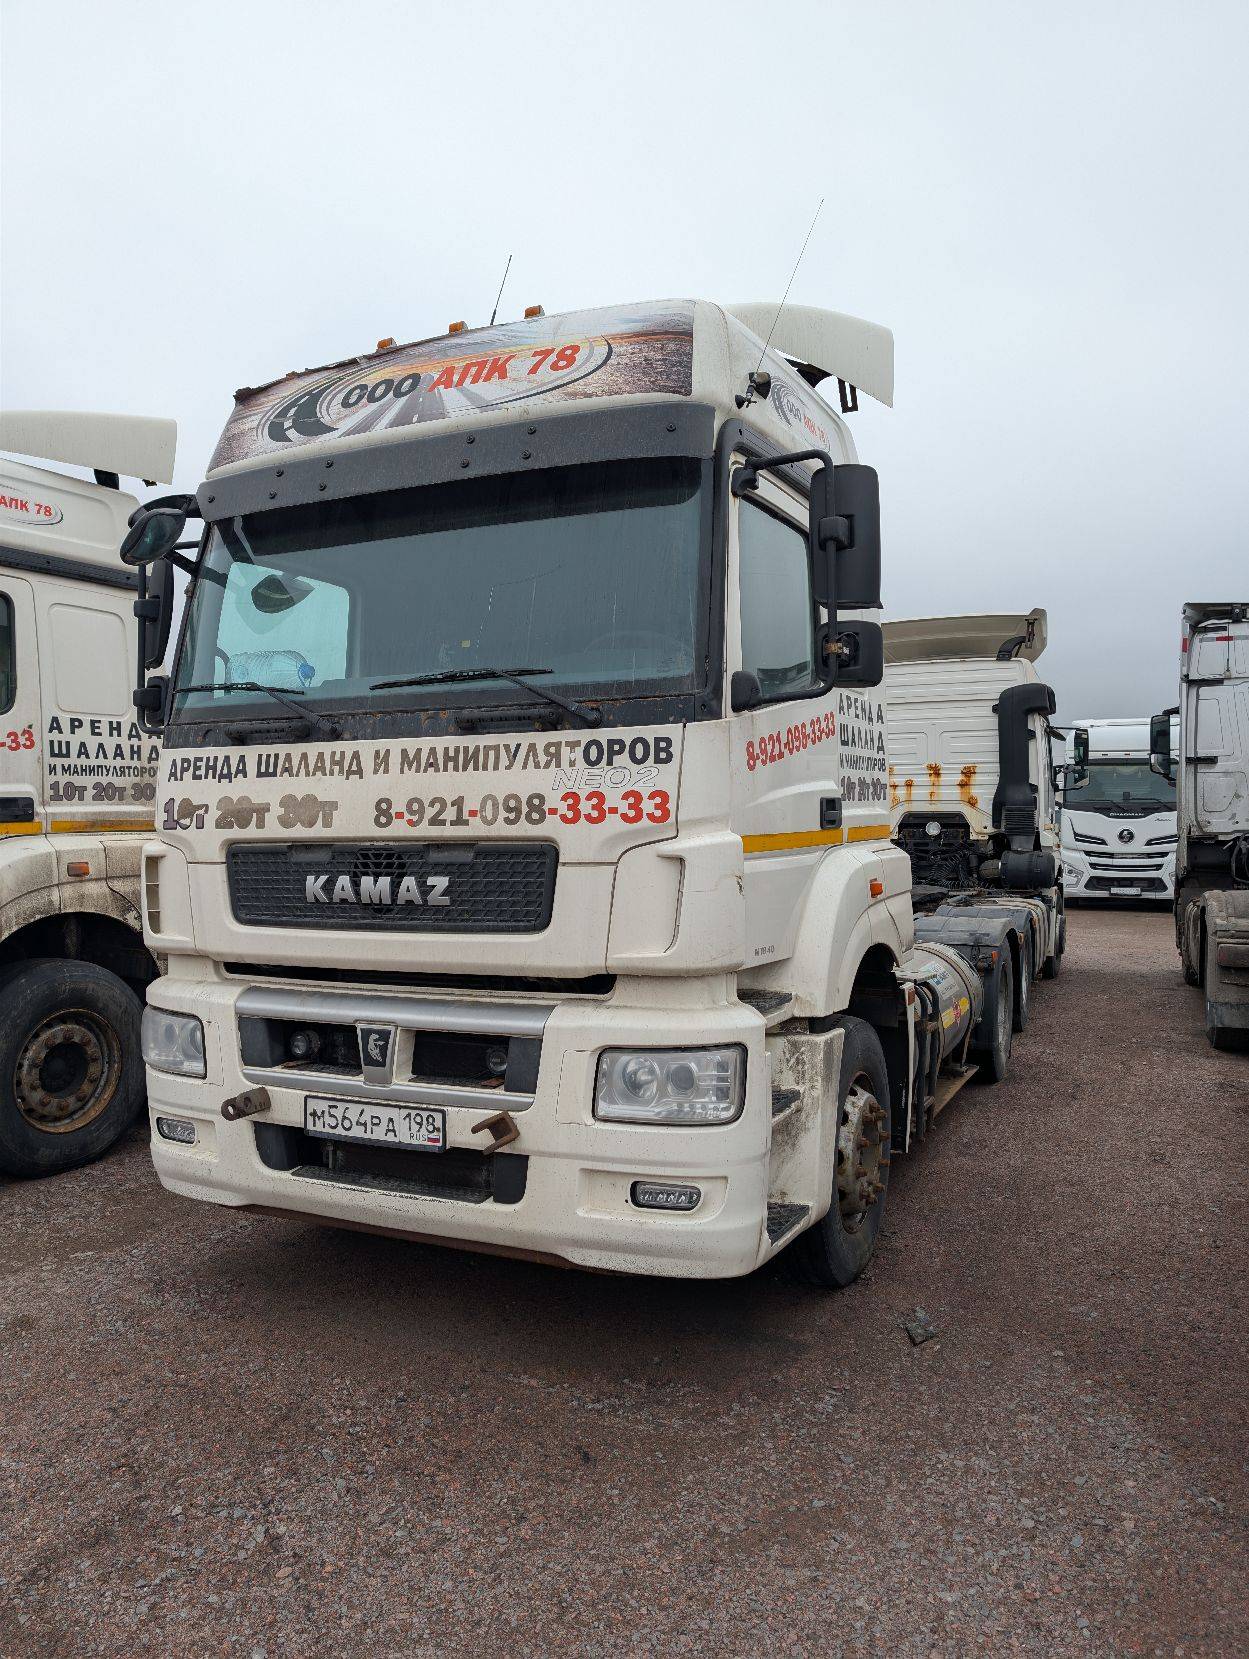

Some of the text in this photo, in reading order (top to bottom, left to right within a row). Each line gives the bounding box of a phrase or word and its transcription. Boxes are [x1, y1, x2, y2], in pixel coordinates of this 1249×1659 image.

[340, 343, 582, 408] ООО АПК 78
[0, 495, 52, 517] АПК 78
[838, 692, 885, 726] АРЕНДА
[746, 711, 836, 771] 8-921-098-33-33
[839, 723, 886, 755] ШАЛАНД
[48, 764, 158, 778] И МАНИПУЛЯТОРО
[168, 737, 674, 783] АРЕНДА ШАЛАНД И МАНИПУЛЯТОРОВ
[373, 790, 671, 829] 8-921-098-33-33
[305, 875, 450, 906] KAMAZ
[409, 1132, 427, 1142] RUS
